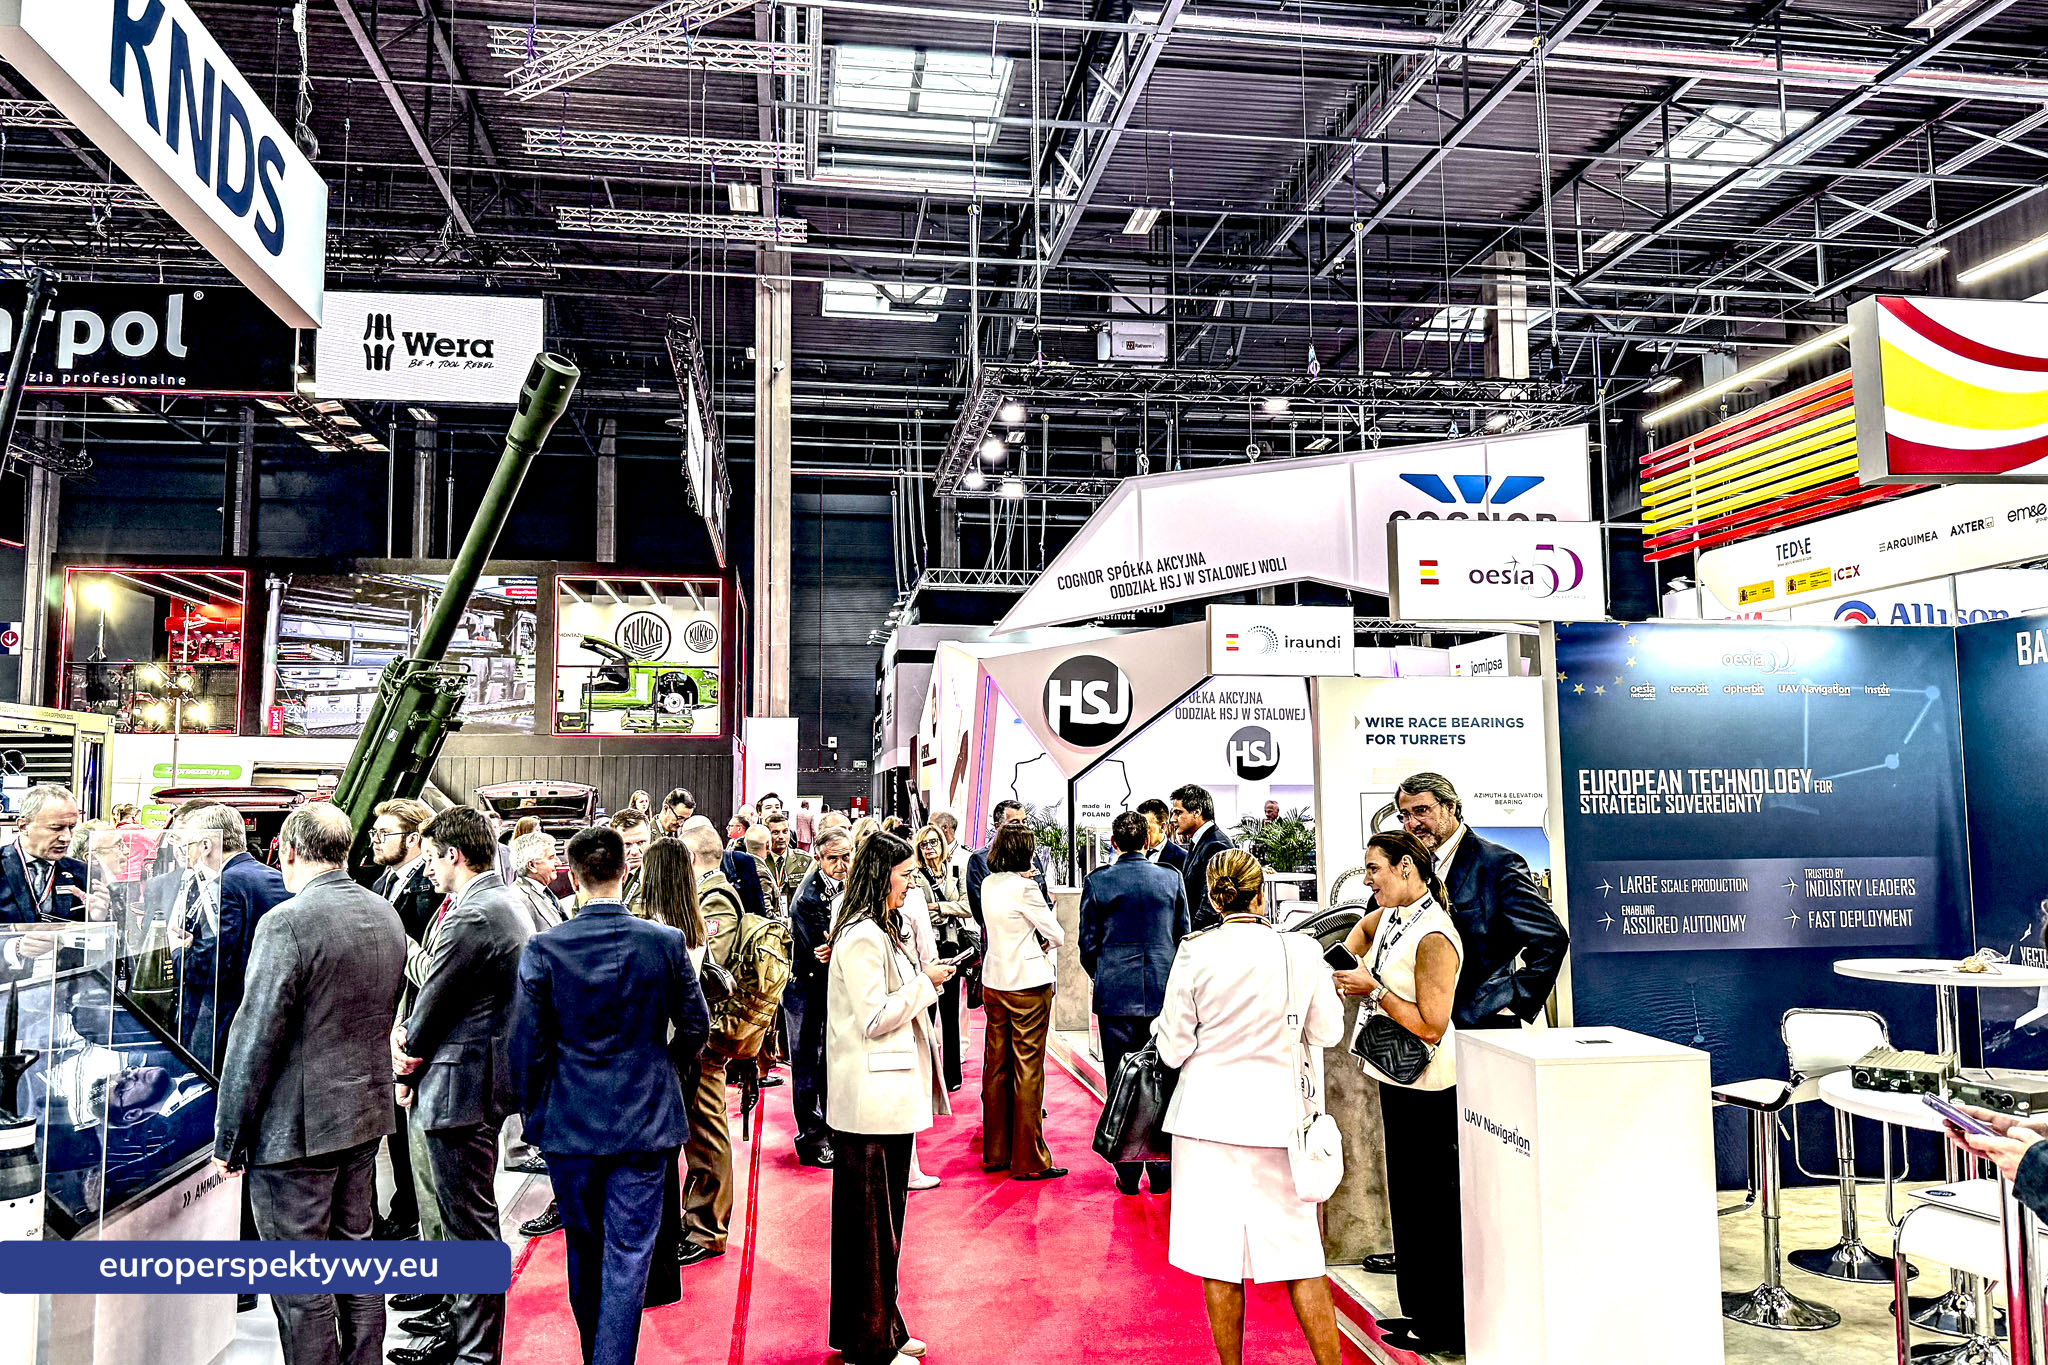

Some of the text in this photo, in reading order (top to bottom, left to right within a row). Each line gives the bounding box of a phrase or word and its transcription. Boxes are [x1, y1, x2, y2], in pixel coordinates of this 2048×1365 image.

[109, 0, 286, 257] KNDS
[401, 331, 495, 358] Wera
[438, 360, 460, 369] TOOL
[463, 360, 495, 370] REBEL
[62, 371, 187, 387] profesjonalne
[1950, 519, 1986, 537] AXTER
[1886, 530, 1938, 551] ARQUIMEA
[1057, 551, 1207, 591] COGNOR SPÓŁKA AKCYJNA
[1110, 556, 1288, 600] ODDZIAŁ HSJ W STALOWEJ WOLI
[624, 615, 663, 650] KUKKO
[1285, 634, 1341, 648] iraundi
[2016, 630, 2048, 667] BA
[1471, 658, 1502, 676] jomipsa
[1218, 692, 1263, 704] AKCYJNA
[1670, 682, 1709, 695] tecnobit
[1723, 682, 1765, 696] cipherbit
[1778, 685, 1801, 694] UAV
[1801, 682, 1850, 696] Navigation
[1048, 666, 1130, 737] HSJ
[1175, 707, 1306, 720] ODDZIAŁ HSJ W STALOWEJ
[1365, 717, 1525, 729] WIRE RACE BEARINGS
[1366, 734, 1466, 745] FOR TURRETS
[1229, 732, 1279, 775] HSJ
[1578, 768, 1833, 795] EUROPEAN TECHNOLOGY FOR
[1580, 793, 1763, 814] STRATEGIC SOVEREIGNTY
[1804, 868, 1844, 879] TRUSTED BY
[1619, 875, 1749, 894] LARGE SCALE PRODUCTION
[1805, 878, 1916, 898] INDUSTRY LEADERS
[1621, 905, 1655, 916] ENABLING
[1808, 909, 1913, 929] FAST DEPLOYMENT
[1622, 914, 1747, 935] ASSURED AUTONOMY
[1464, 1107, 1530, 1151] UAV Navigation
